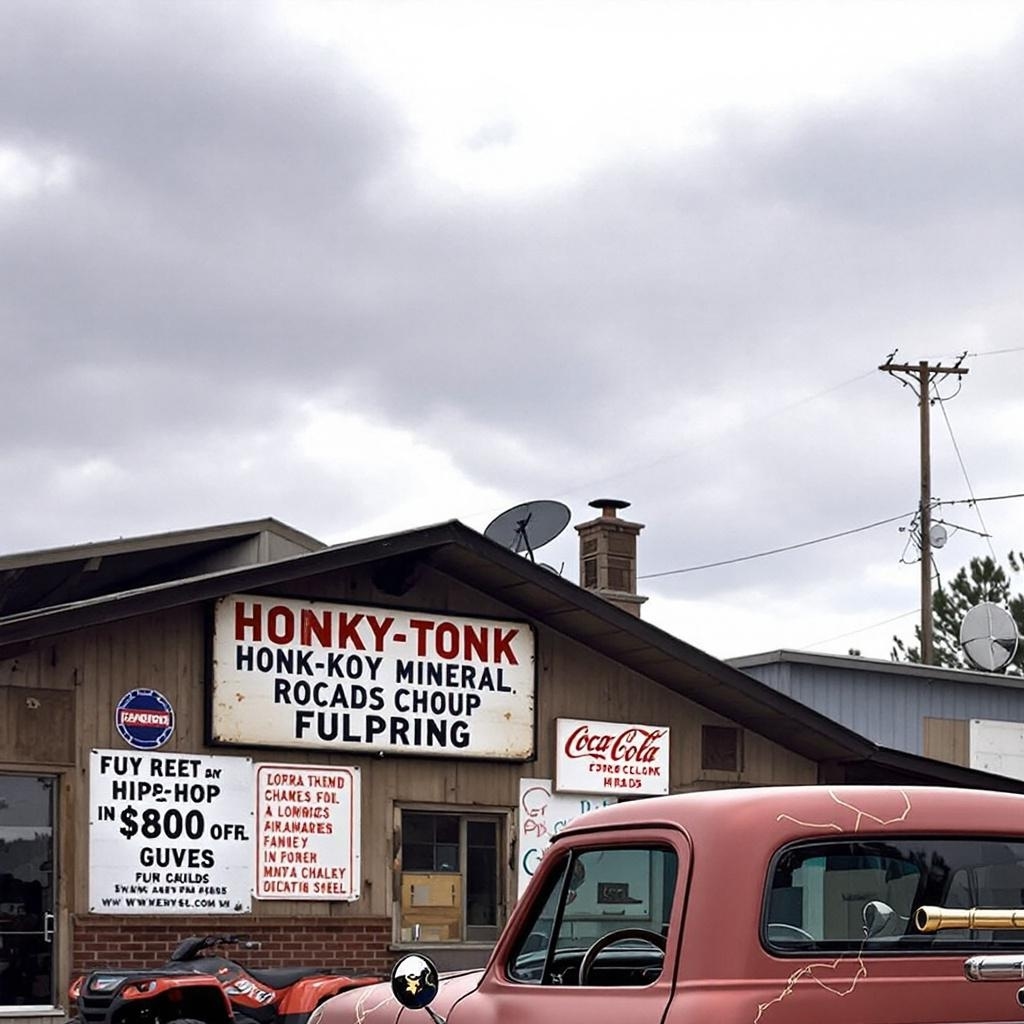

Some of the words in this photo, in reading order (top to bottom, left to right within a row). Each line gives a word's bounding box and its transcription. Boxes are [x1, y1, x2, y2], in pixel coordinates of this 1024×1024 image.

[234, 601, 519, 665] HONKY-TONK
[236, 645, 383, 681] HONK-KOY
[274, 678, 385, 711] ROCADS
[395, 688, 481, 716] CHOUP
[295, 710, 470, 748] FULPRING
[101, 756, 142, 775] FUY
[151, 758, 201, 777] REET
[98, 806, 115, 821] IN
[120, 805, 205, 840] $800
[140, 847, 215, 868] GUVES
